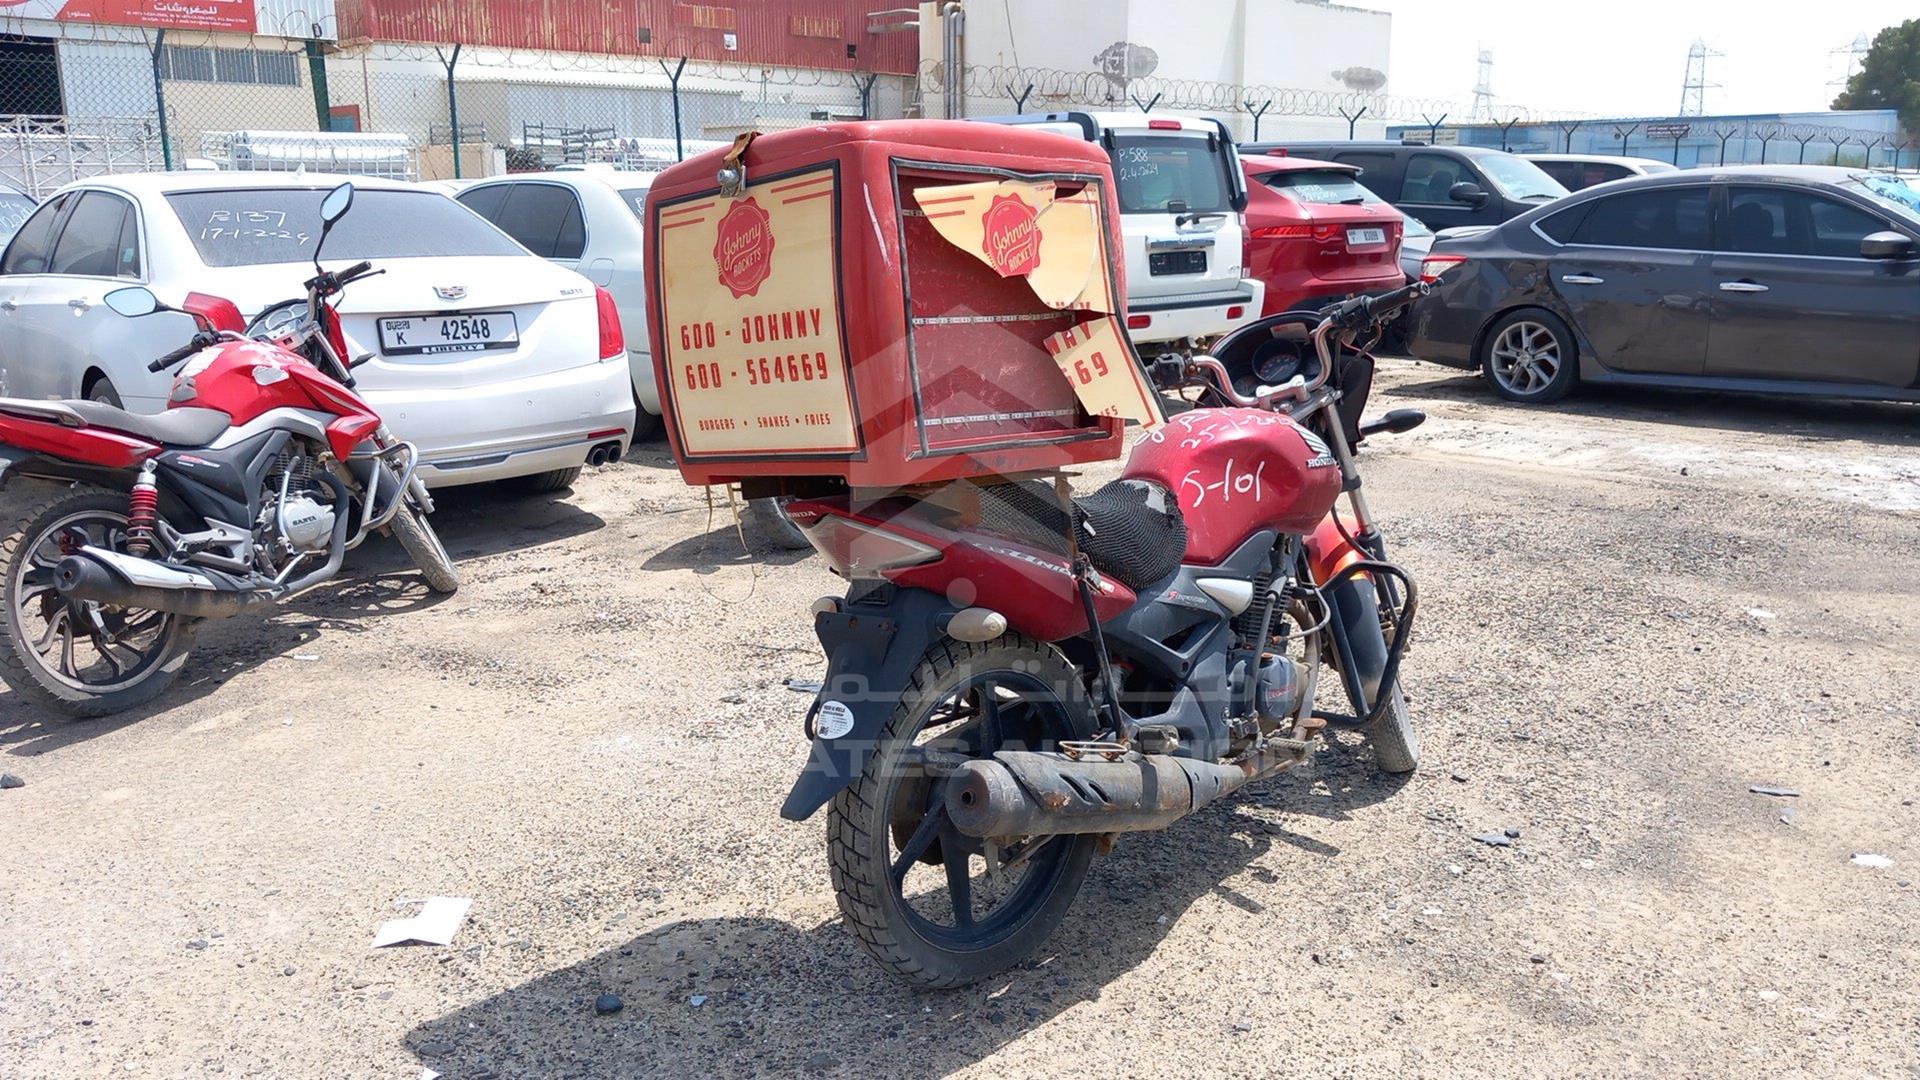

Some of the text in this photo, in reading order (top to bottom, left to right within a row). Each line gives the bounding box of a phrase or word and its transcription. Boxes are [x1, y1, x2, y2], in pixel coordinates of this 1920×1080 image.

[723, 222, 761, 271] Johnny
[733, 247, 761, 278] ROCKETS
[397, 332, 407, 345] K
[441, 318, 491, 341] 42548
[681, 321, 716, 351] 600
[742, 308, 820, 344] JOHNNY
[685, 362, 722, 390] 600
[746, 352, 828, 386] 564669
[699, 412, 831, 432] BURGERS SHAKES FRIES
[1306, 456, 1337, 468] HONDA
